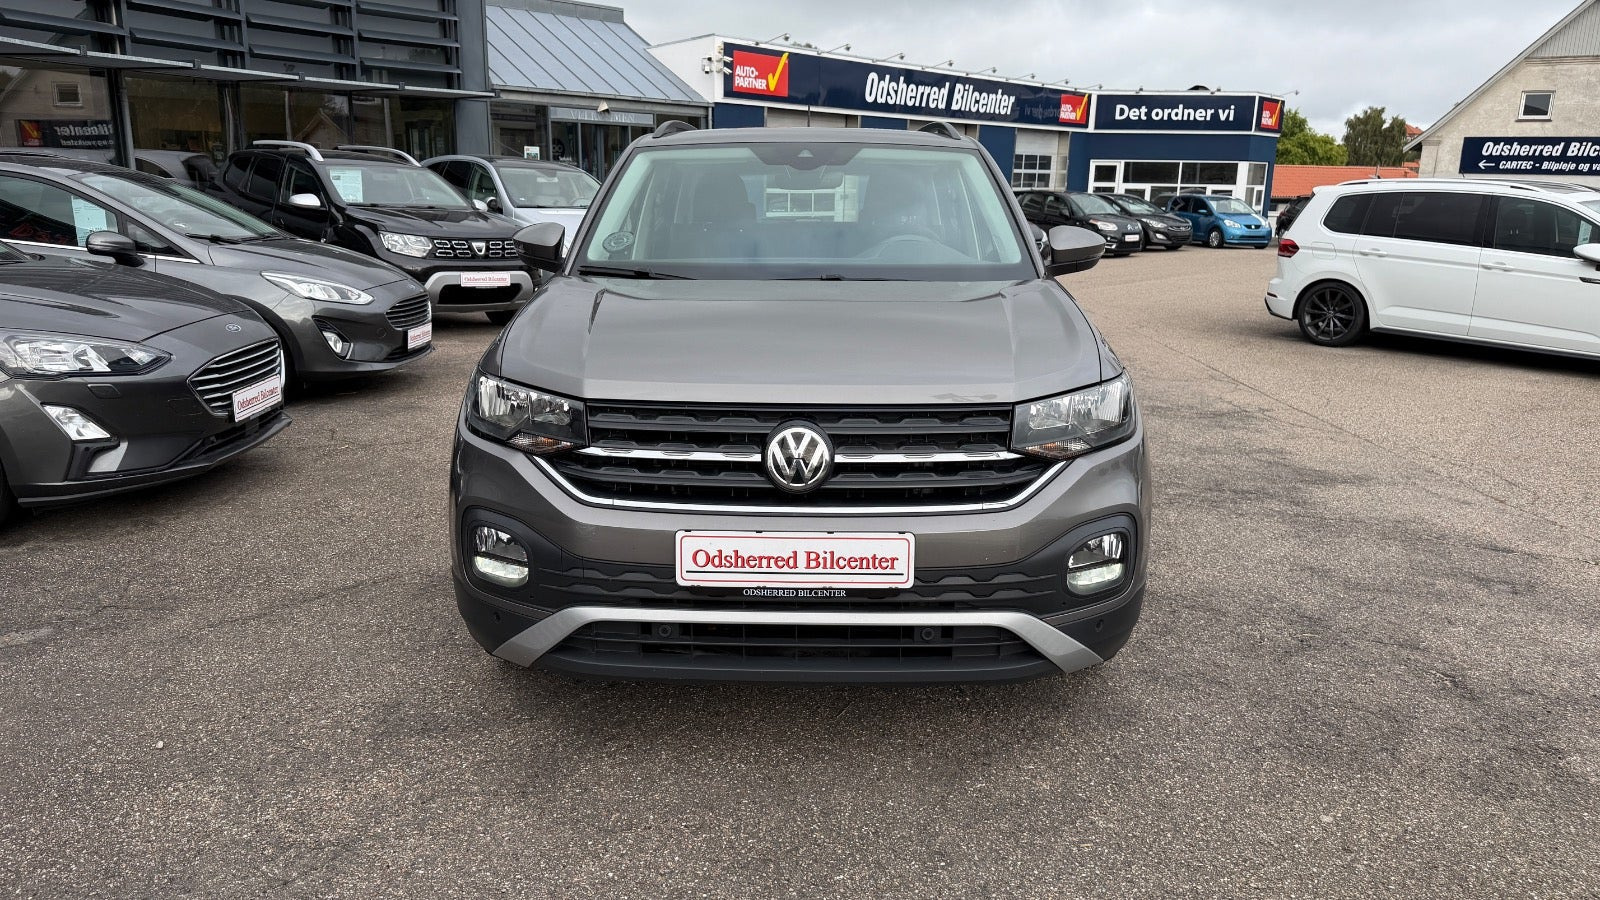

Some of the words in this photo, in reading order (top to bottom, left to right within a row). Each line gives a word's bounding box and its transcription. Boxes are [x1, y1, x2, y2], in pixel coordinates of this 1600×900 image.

[735, 64, 759, 78] AUTO-
[734, 75, 767, 90] PARTNER
[865, 72, 950, 109] Odsherred
[951, 83, 1015, 115] Bilcenter
[1114, 104, 1148, 121] Det
[1150, 104, 1215, 121] ordner
[1218, 105, 1235, 121] vi
[1481, 141, 1565, 157] Odsherred
[1499, 160, 1533, 170] CARTEC
[1541, 161, 1576, 172] Bilpleje
[1578, 163, 1591, 172] og
[691, 549, 799, 570] Odsherred
[804, 550, 899, 570] Bilcenter
[743, 588, 796, 597] ODSHERRED
[797, 588, 847, 597] BILCENTER
